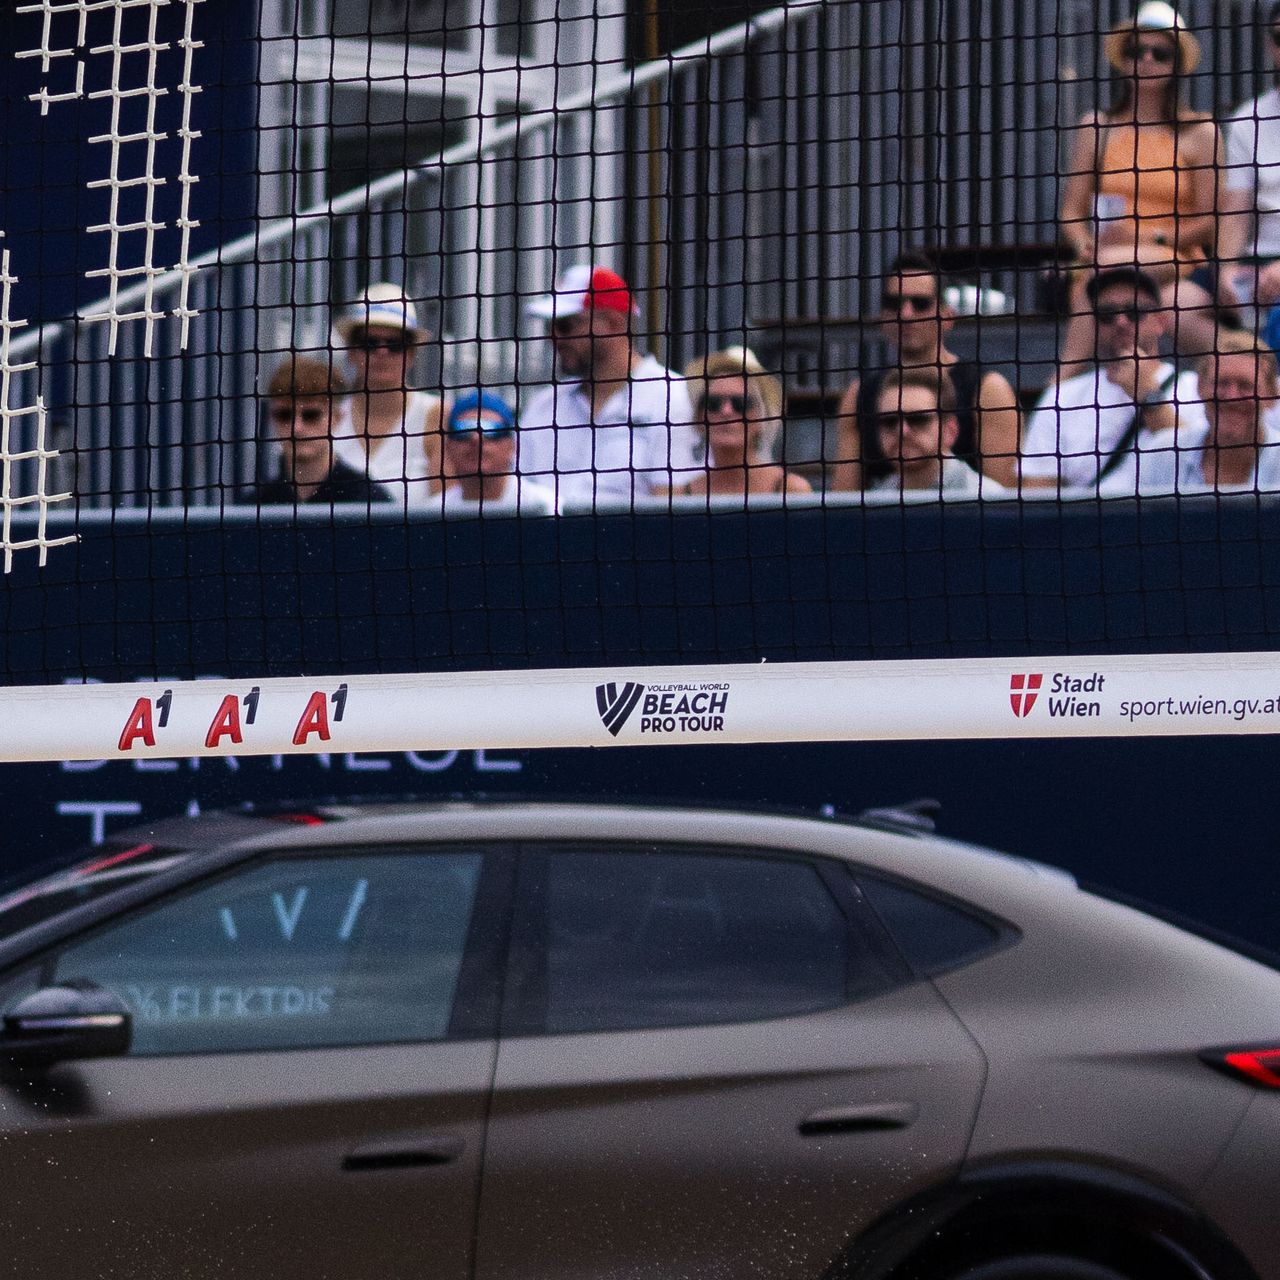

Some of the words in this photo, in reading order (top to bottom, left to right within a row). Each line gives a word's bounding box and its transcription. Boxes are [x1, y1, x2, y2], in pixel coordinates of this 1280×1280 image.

[647, 683, 698, 692] VOLLEYBALL
[699, 682, 730, 691] WORLD
[1050, 672, 1106, 694] Stadt
[291, 683, 348, 746] A1
[642, 692, 729, 716] BEACH
[1047, 696, 1102, 717] Wien
[118, 688, 173, 752] A1
[204, 686, 261, 749] A1
[640, 717, 676, 733] PRO
[678, 715, 724, 732] TOUR
